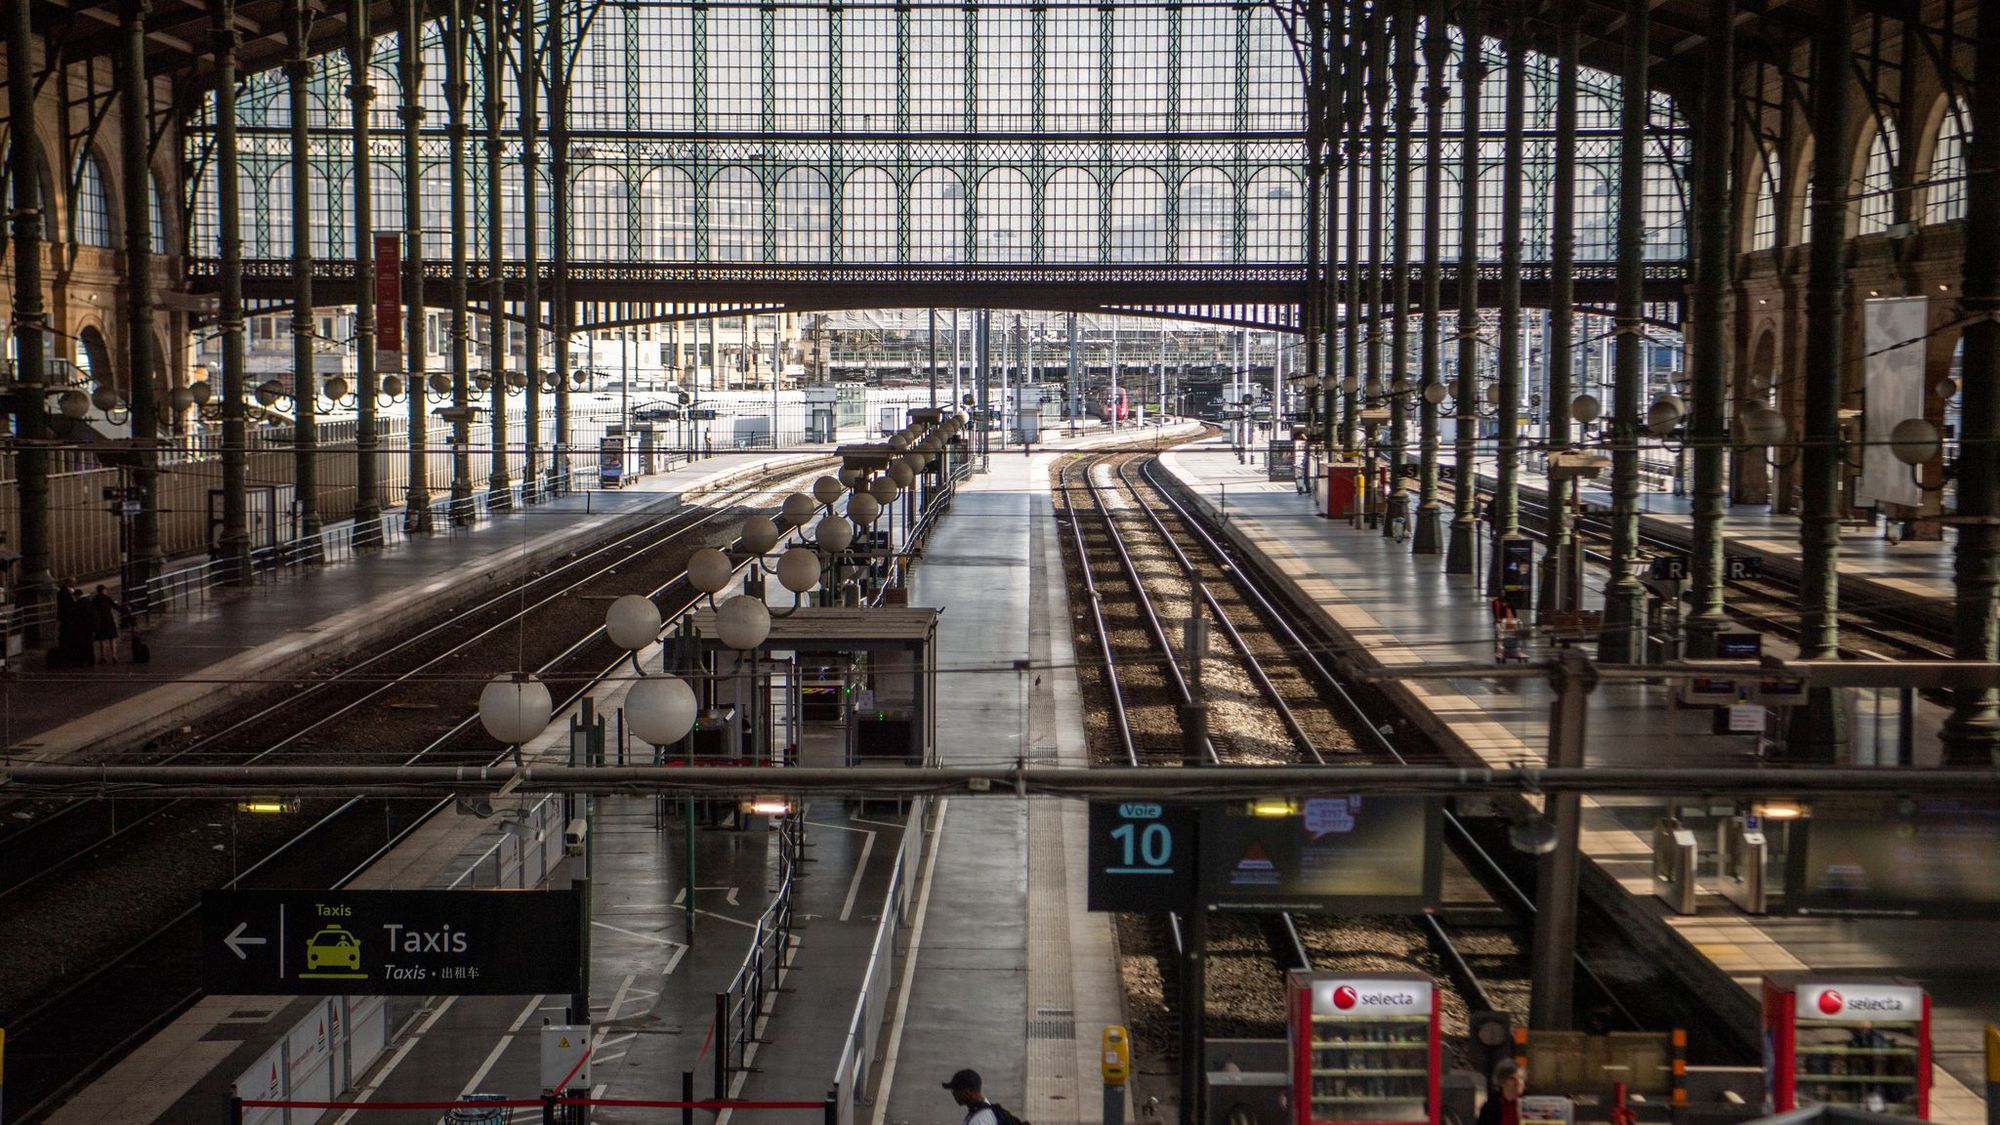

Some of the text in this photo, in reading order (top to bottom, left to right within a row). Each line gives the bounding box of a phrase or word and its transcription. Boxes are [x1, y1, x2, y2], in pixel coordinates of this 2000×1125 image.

[1443, 467, 1452, 478] S
[1669, 562, 1683, 578] R
[1731, 562, 1745, 579] R
[1125, 805, 1157, 817] Voie
[1110, 823, 1172, 866] 10
[315, 903, 352, 917] Taxis
[382, 923, 468, 953] Taxis
[384, 964, 480, 980] Taxis 出租车
[1361, 992, 1414, 1005] selecta
[1847, 997, 1903, 1010] selecta
